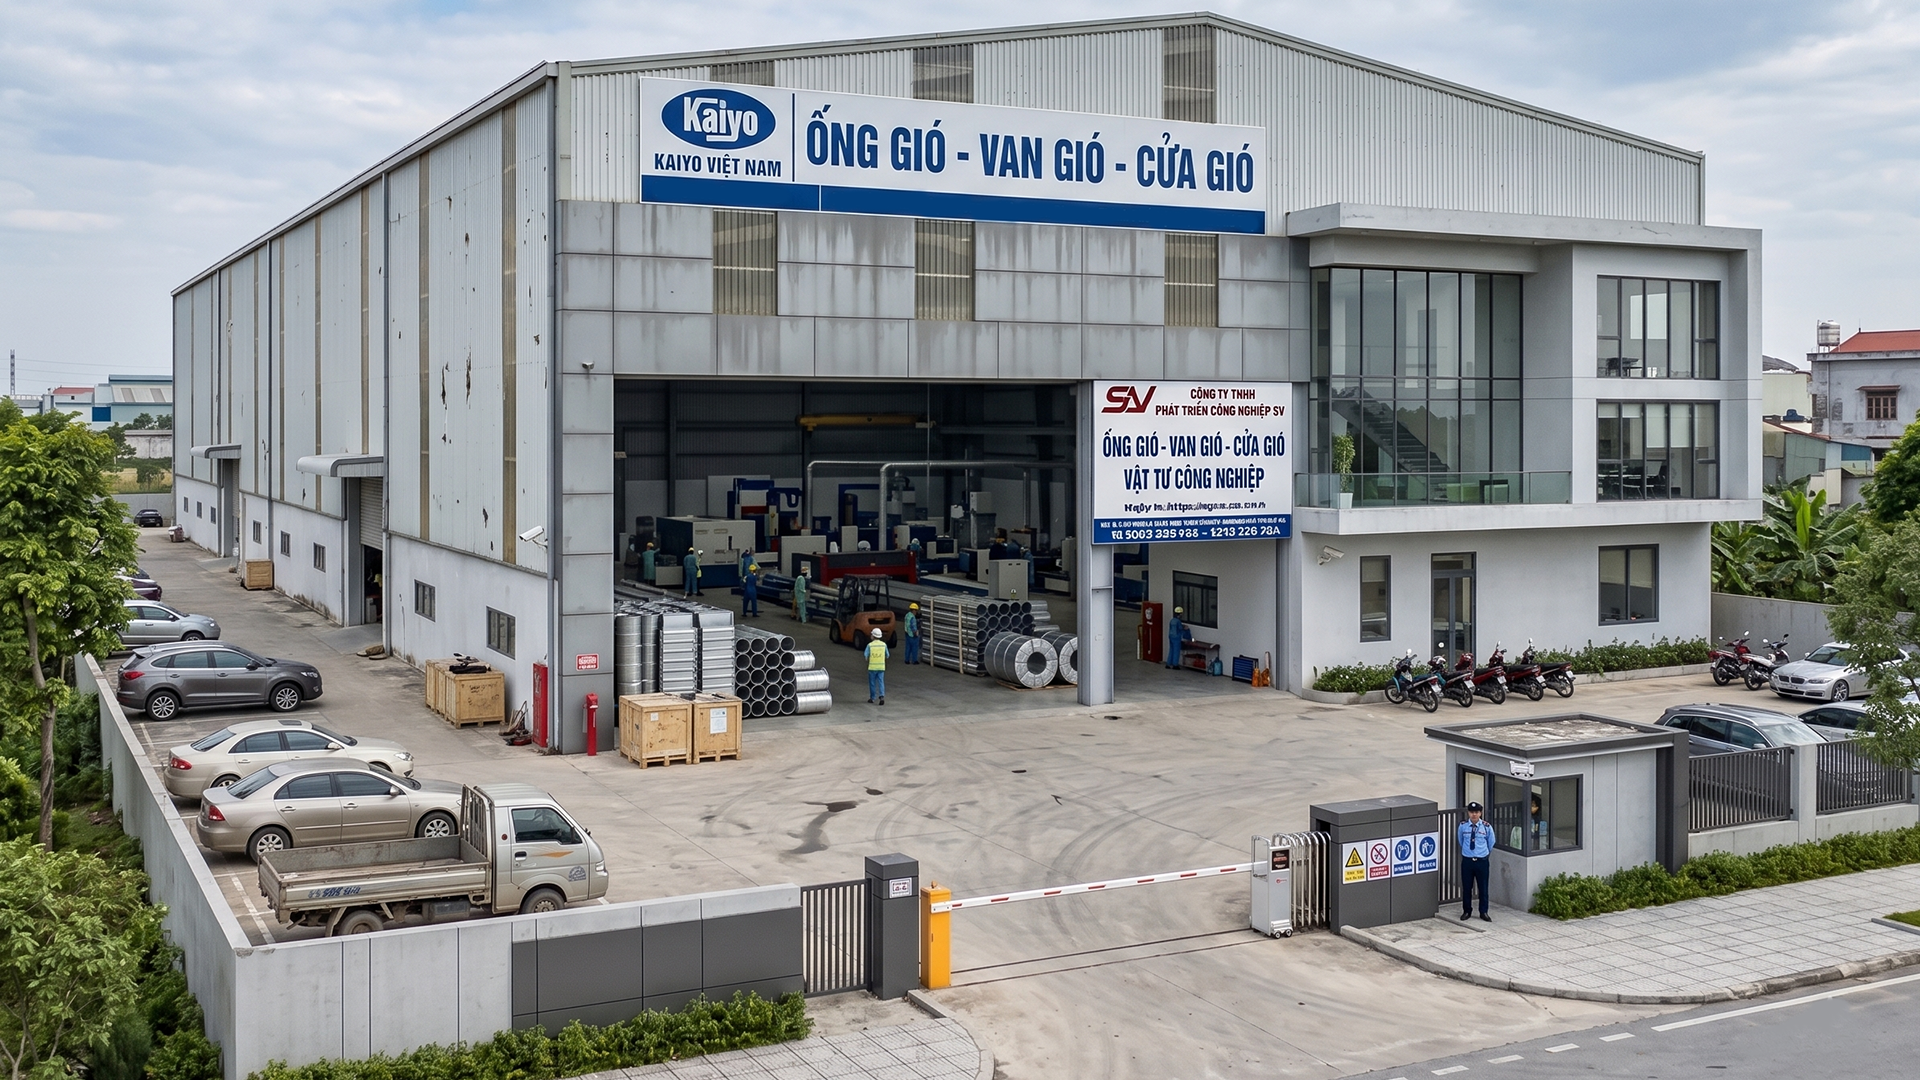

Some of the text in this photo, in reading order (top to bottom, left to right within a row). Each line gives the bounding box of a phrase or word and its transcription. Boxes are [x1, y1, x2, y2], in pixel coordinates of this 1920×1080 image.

[683, 96, 759, 142] Kaiyo
[806, 104, 878, 169] ỐNG
[890, 120, 946, 174] GIÓ
[979, 133, 1043, 179] VAN
[1054, 132, 1104, 183] GIÓ
[1137, 132, 1197, 189] CỬA
[1207, 143, 1253, 193] GIÓ
[654, 153, 781, 178] KAIYO VIỆT NAM
[1101, 385, 1157, 413] SV
[1217, 388, 1229, 399] TY
[1231, 388, 1255, 399] TNHH
[1155, 402, 1180, 416] PHÁT
[1238, 403, 1271, 419] NGHIỆP
[1273, 405, 1285, 416] SV
[1102, 428, 1131, 457] ỐNG
[1136, 431, 1158, 457] GIÓ
[1169, 435, 1196, 457] VAN
[1200, 431, 1222, 457] GIÓ
[1233, 428, 1260, 457] CỬA
[1263, 431, 1285, 456] GIÓ
[1123, 463, 1265, 494] VẬT TƯ CÔNG NGHIỆP
